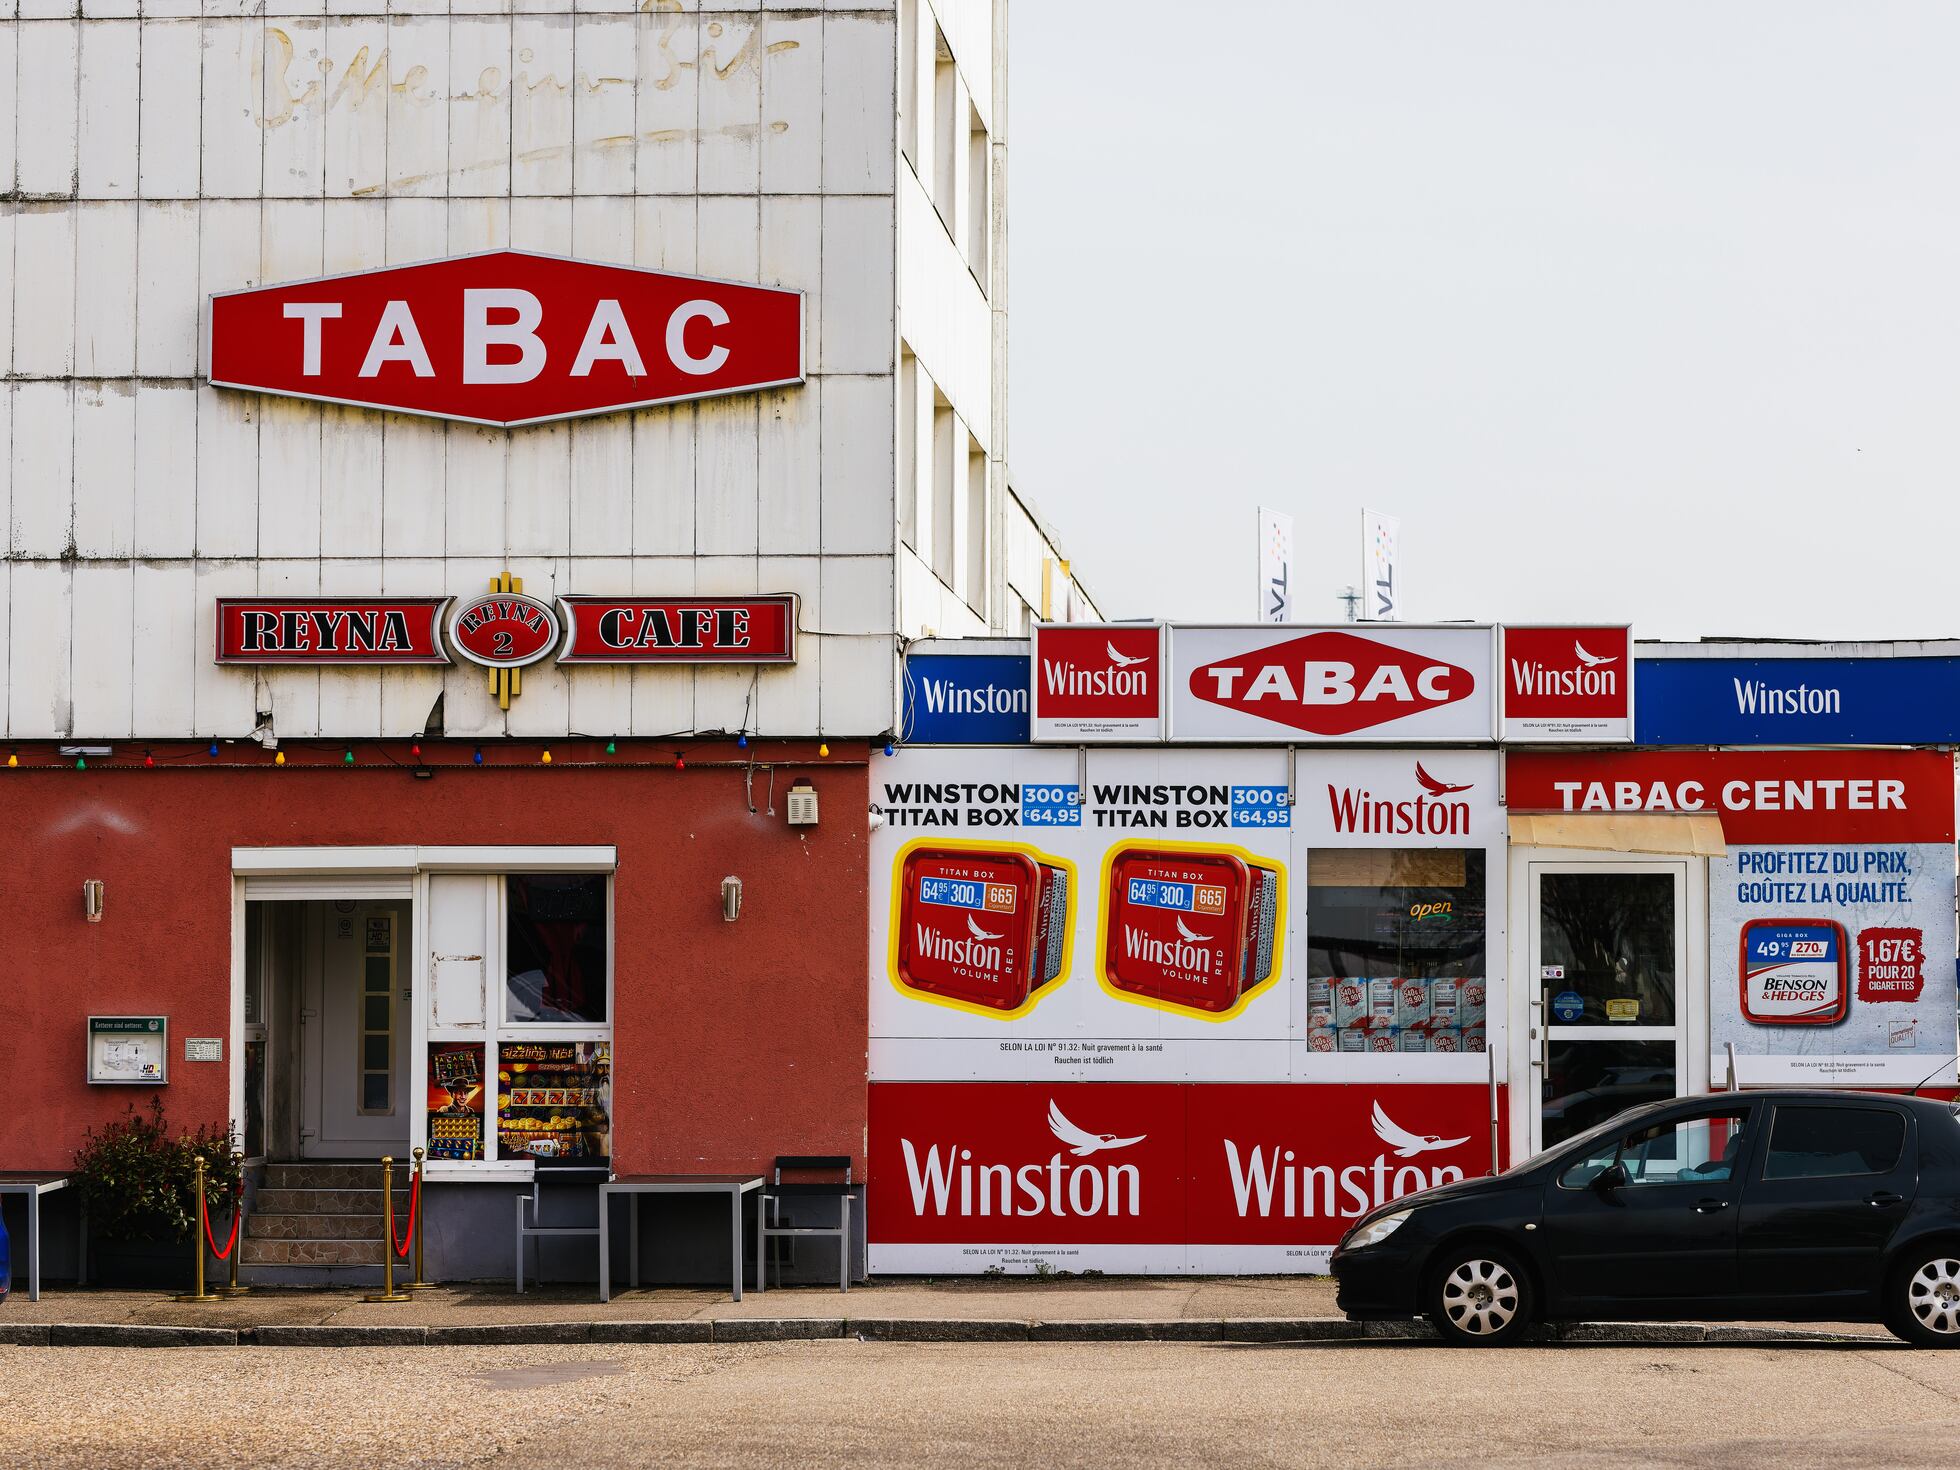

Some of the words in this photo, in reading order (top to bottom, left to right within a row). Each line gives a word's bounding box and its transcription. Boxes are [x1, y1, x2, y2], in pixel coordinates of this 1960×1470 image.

[283, 288, 730, 385] TABAC
[460, 600, 545, 635] REYNA
[599, 608, 751, 649] CAFE
[241, 611, 413, 651] REYNA
[492, 631, 513, 656] 2
[1043, 657, 1147, 696] Winston
[1208, 661, 1450, 705] TABAC
[1511, 657, 1617, 696] Winston
[923, 676, 1028, 714] Winston
[1734, 677, 1840, 714] Winston
[884, 784, 1020, 804] WINSTON
[1024, 788, 1065, 804] 300
[1068, 791, 1080, 808] g
[1093, 785, 1229, 806] WINSTON
[1233, 789, 1275, 805] 300
[1276, 792, 1289, 810] g
[1554, 781, 1705, 812] TABAC
[1721, 779, 1907, 811] CENTER
[885, 808, 964, 827] TITAN
[968, 808, 1020, 827] BOX
[1024, 809, 1079, 827] €64,95
[1093, 810, 1172, 829] TITAN
[1177, 810, 1229, 829] BOX
[1233, 810, 1289, 828] €64,95
[1327, 783, 1470, 835] Winston
[940, 868, 968, 877] TITAN
[1148, 869, 1178, 878] TITAN
[1183, 872, 1203, 880] BOX
[1738, 851, 1828, 874] PROFITEZ
[1833, 851, 1859, 874] DU
[1864, 851, 1912, 876] PRIX,
[923, 881, 938, 899] 64
[951, 883, 975, 904] 300
[990, 888, 1013, 904] 665
[1131, 882, 1146, 901] 64
[1160, 885, 1184, 906] 300
[1199, 889, 1222, 906] 665
[1738, 877, 1807, 903] GOÛTEZ
[1811, 882, 1832, 903] LA
[1835, 875, 1912, 906] QUALITÉ.
[1410, 901, 1453, 921] open
[917, 922, 1001, 971] Winston
[1125, 923, 1210, 973] Winston
[1757, 941, 1780, 956] 49
[1795, 943, 1819, 953] 270
[1866, 939, 1915, 965] 1,67€
[1005, 948, 1014, 974] RED
[1215, 950, 1223, 975] RED
[1868, 965, 1899, 979] POUR
[1901, 965, 1915, 979] 20
[953, 967, 999, 982] VOLUME
[1162, 968, 1208, 984] VOLUME
[1764, 978, 1828, 990] BENSON
[1868, 981, 1915, 990] CIGARETTES
[1000, 1043, 1022, 1051] SELON
[1024, 1043, 1033, 1051] LA
[1034, 1043, 1045, 1051] LOI
[1082, 1043, 1095, 1051] Nuit
[1097, 1043, 1130, 1052] gravement
[1131, 1043, 1136, 1051] à
[1138, 1043, 1144, 1051] la
[1145, 1043, 1163, 1051] santé
[1054, 1056, 1081, 1064] Rauchen
[1083, 1056, 1091, 1064] ist
[1093, 1056, 1114, 1064] tödlich
[901, 1138, 1140, 1217] Winston
